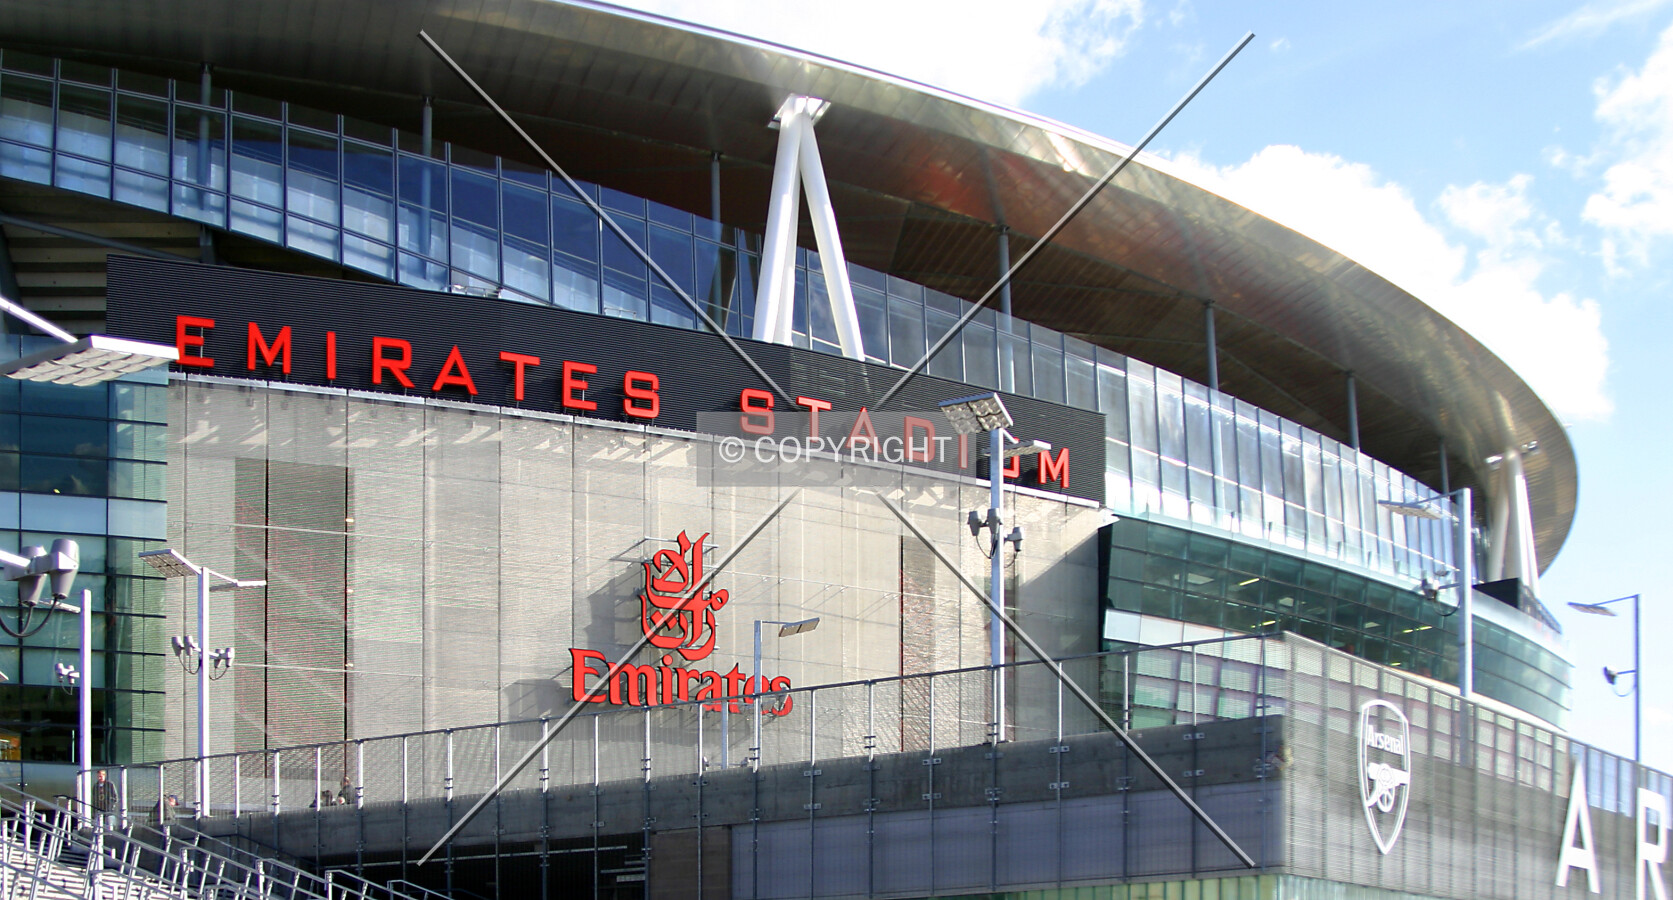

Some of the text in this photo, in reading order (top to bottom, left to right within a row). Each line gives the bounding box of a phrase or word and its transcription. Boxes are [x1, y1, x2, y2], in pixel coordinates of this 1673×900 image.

[176, 316, 660, 419] EMIRATES
[569, 647, 793, 717] Emirates
[1367, 724, 1403, 756] Arsenal
